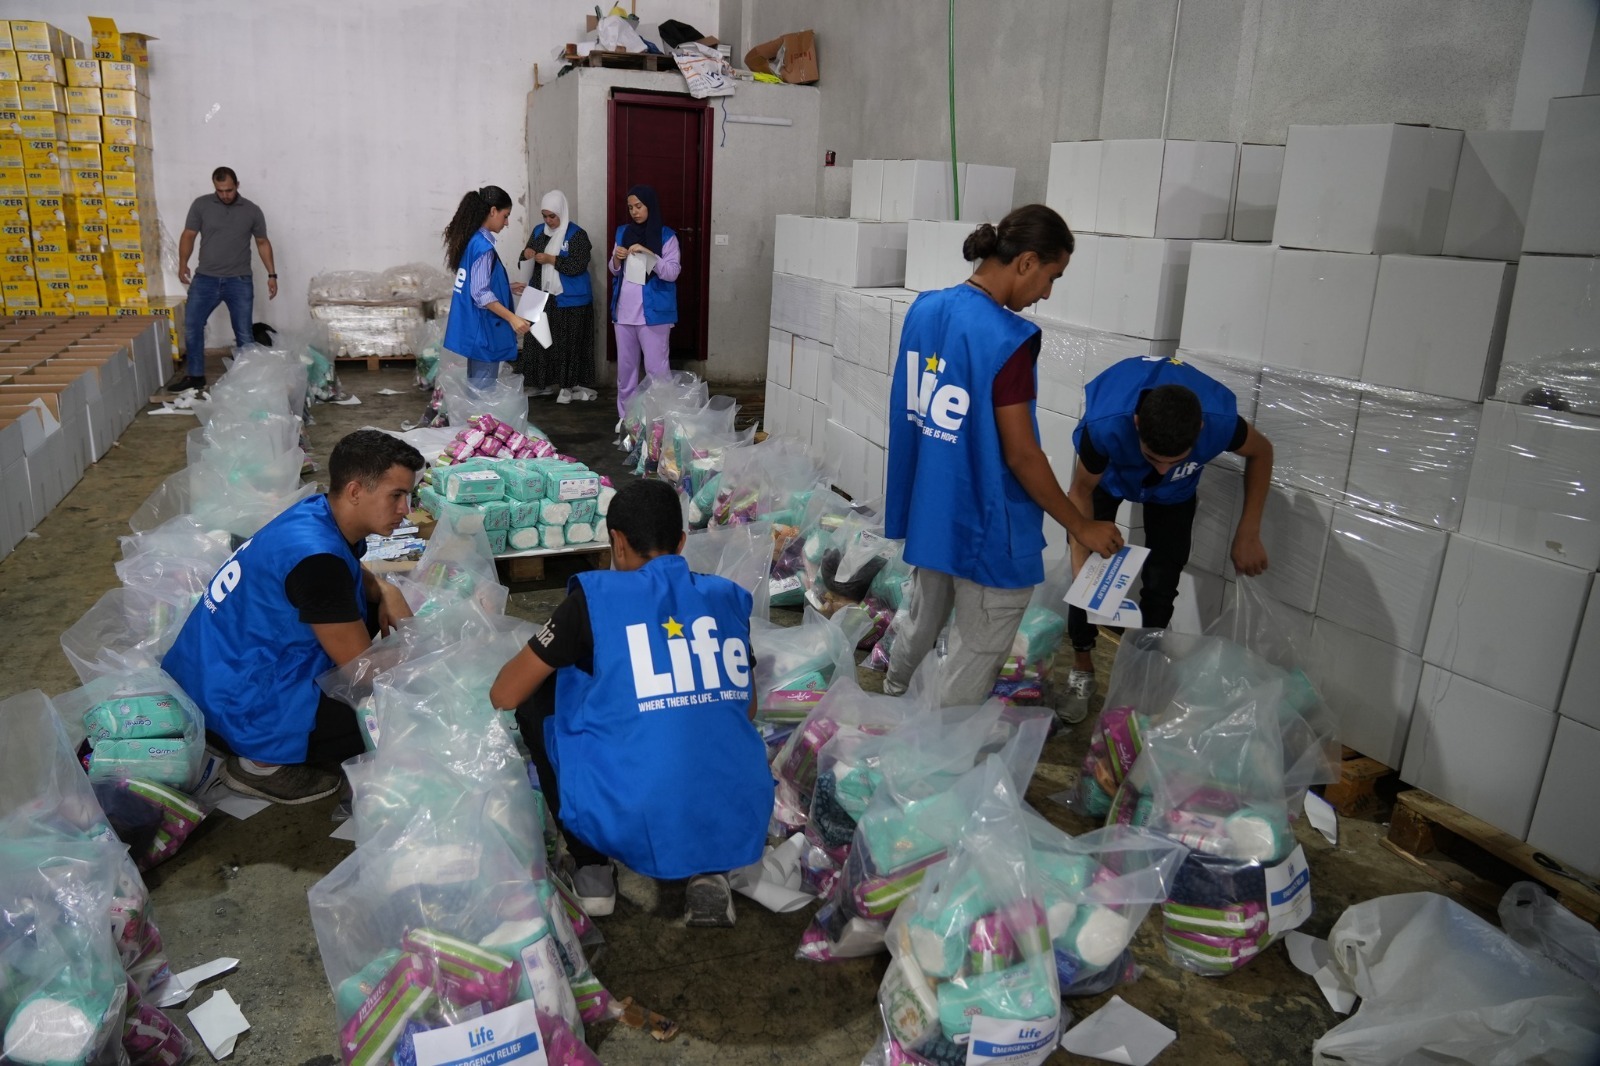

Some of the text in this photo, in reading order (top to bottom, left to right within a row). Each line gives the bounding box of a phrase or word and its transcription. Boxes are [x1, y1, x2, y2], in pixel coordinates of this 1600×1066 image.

[940, 431, 958, 444] HOPE
[1171, 462, 1199, 480] Lif
[1097, 556, 1122, 600] EMERGENCY RELIEF
[1115, 574, 1130, 589] Life
[626, 616, 749, 699] Life
[638, 698, 665, 712] WHERE
[666, 696, 689, 708] THERE
[690, 695, 698, 705] IS
[698, 693, 719, 703] LIFE...
[468, 1026, 494, 1048] Life
[1018, 1027, 1041, 1039] Life
[497, 1043, 522, 1060] RELIEF
[992, 1042, 1035, 1054] EMERGENCY
